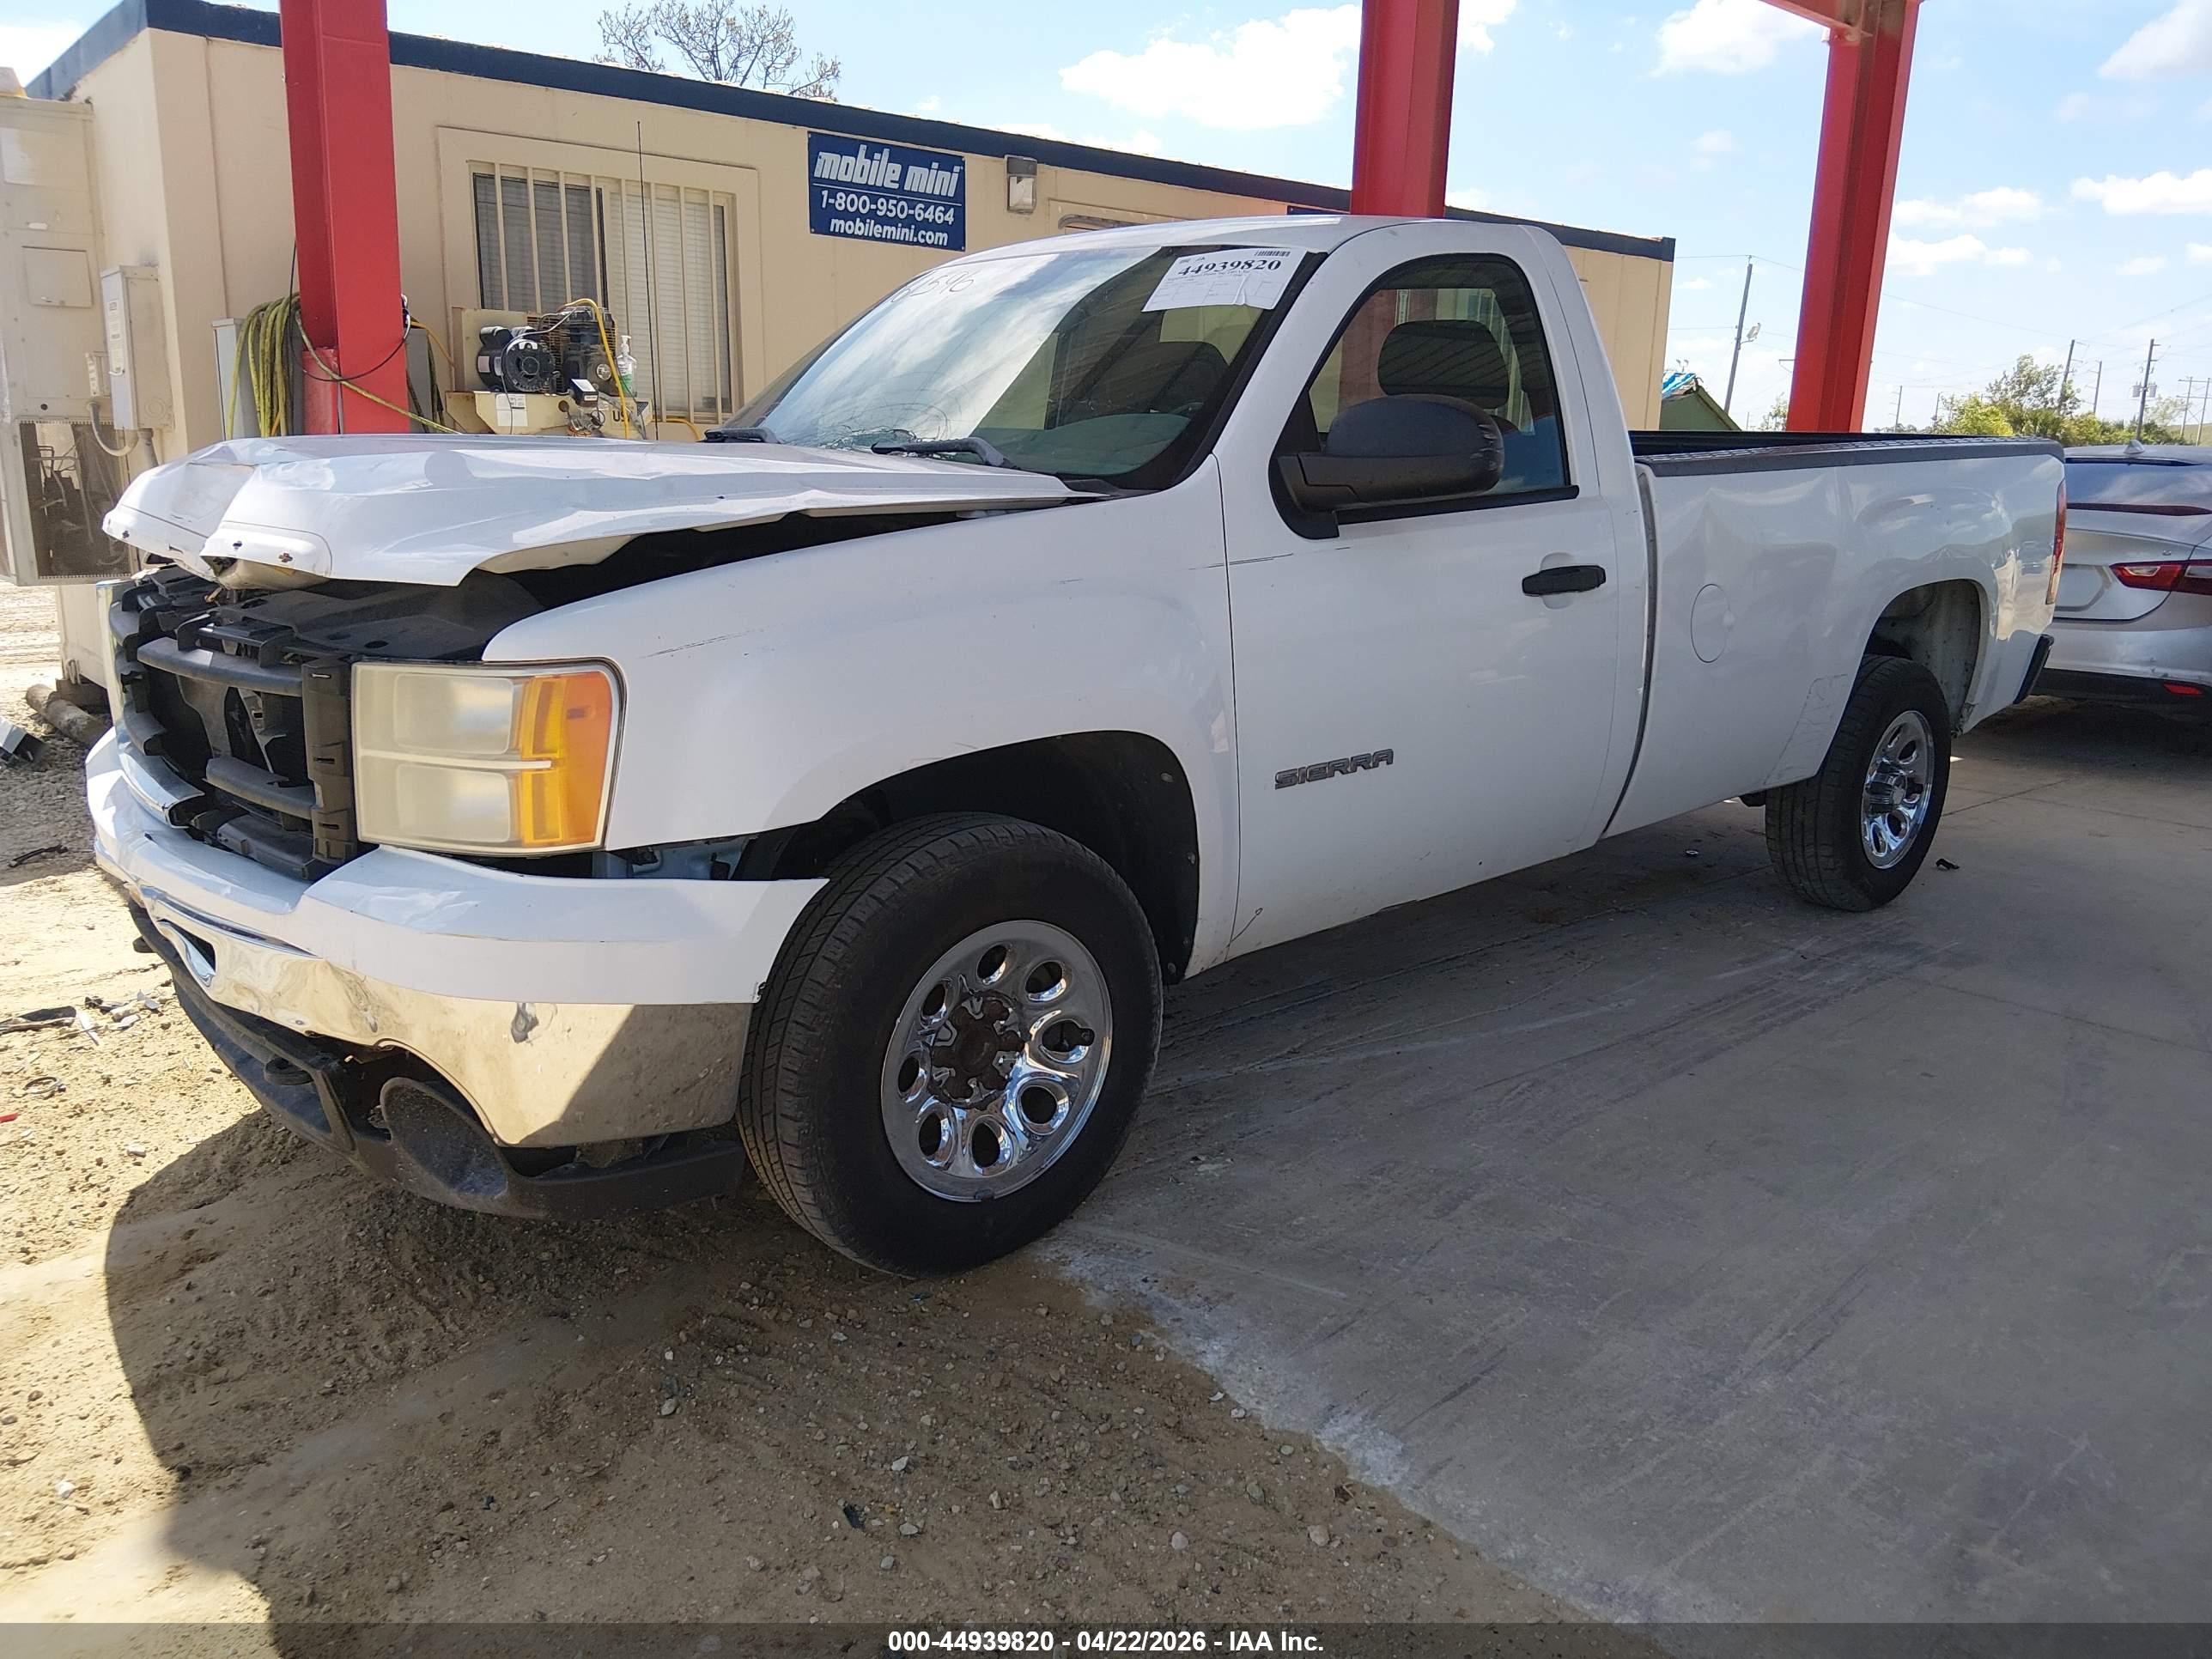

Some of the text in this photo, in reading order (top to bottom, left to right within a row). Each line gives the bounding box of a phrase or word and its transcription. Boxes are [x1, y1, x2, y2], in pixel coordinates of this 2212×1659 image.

[813, 143, 962, 198] mobile mini
[821, 190, 955, 225] 1-800-950-6464
[830, 217, 949, 246] mobilemini.com
[1178, 258, 1282, 276] 44939820
[1275, 748, 1395, 790] SIERRA
